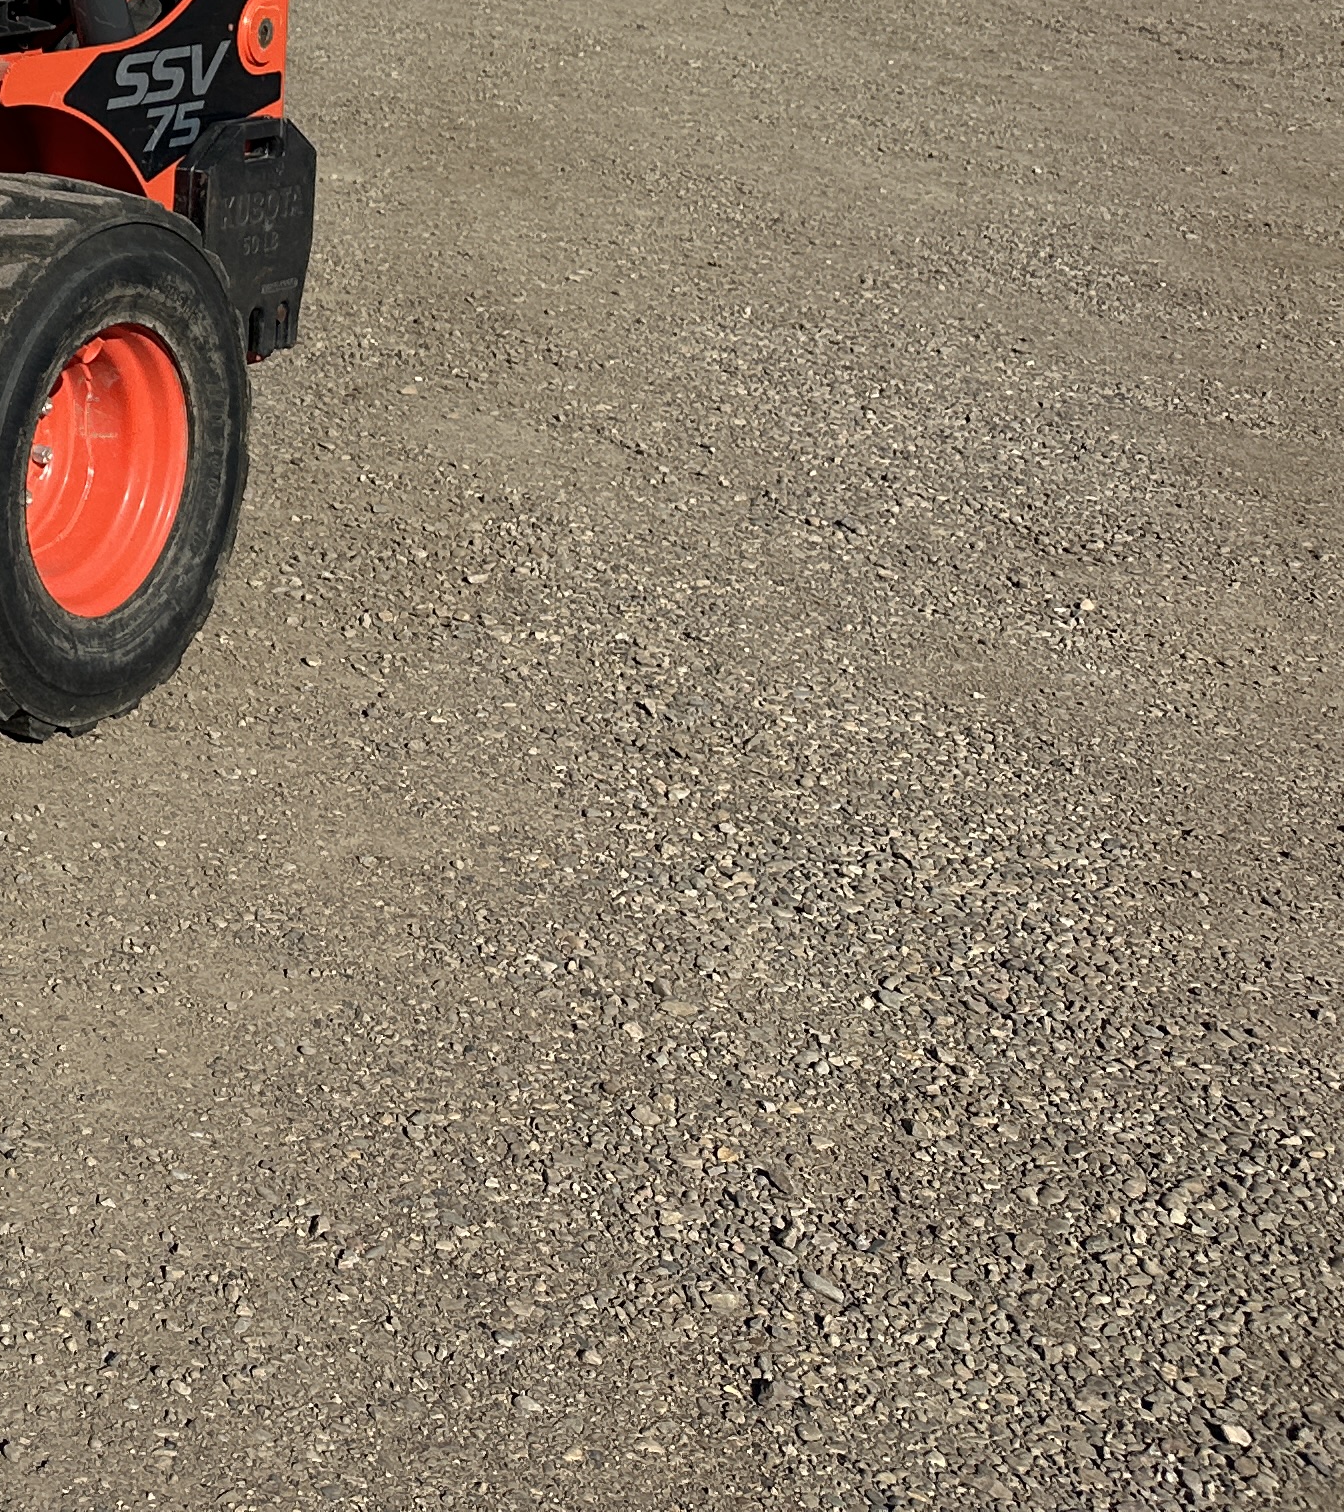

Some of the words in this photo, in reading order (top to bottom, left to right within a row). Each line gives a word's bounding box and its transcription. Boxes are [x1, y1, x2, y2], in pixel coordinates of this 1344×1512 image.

[106, 39, 232, 111] SSV
[142, 99, 205, 154] 75
[220, 184, 305, 230] KUBOTA
